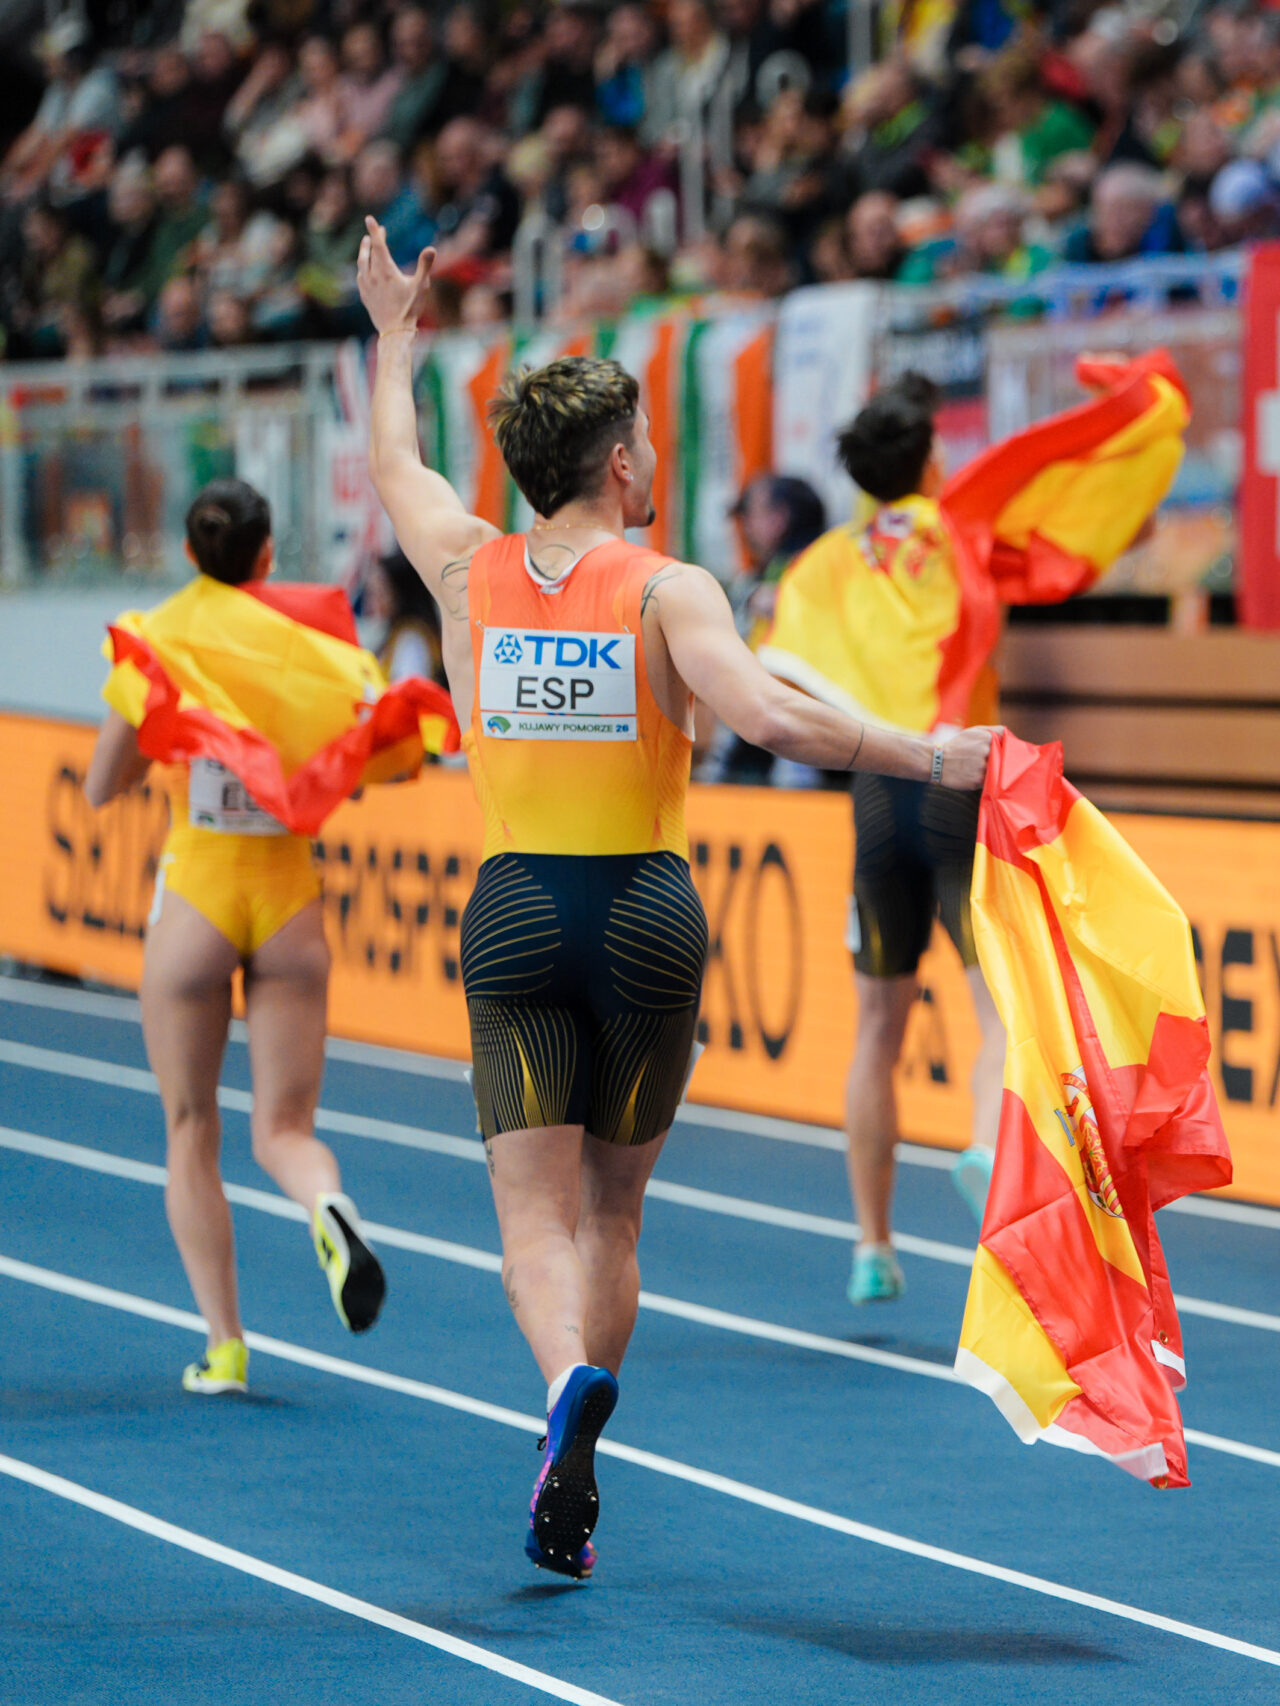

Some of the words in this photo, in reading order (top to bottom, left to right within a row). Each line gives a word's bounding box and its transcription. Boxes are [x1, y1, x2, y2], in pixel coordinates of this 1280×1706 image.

[524, 635, 622, 669] TDK
[516, 675, 595, 710] ESP
[519, 722, 560, 733] KUJAWY
[563, 723, 613, 733] POMORZE
[615, 723, 629, 733] 26
